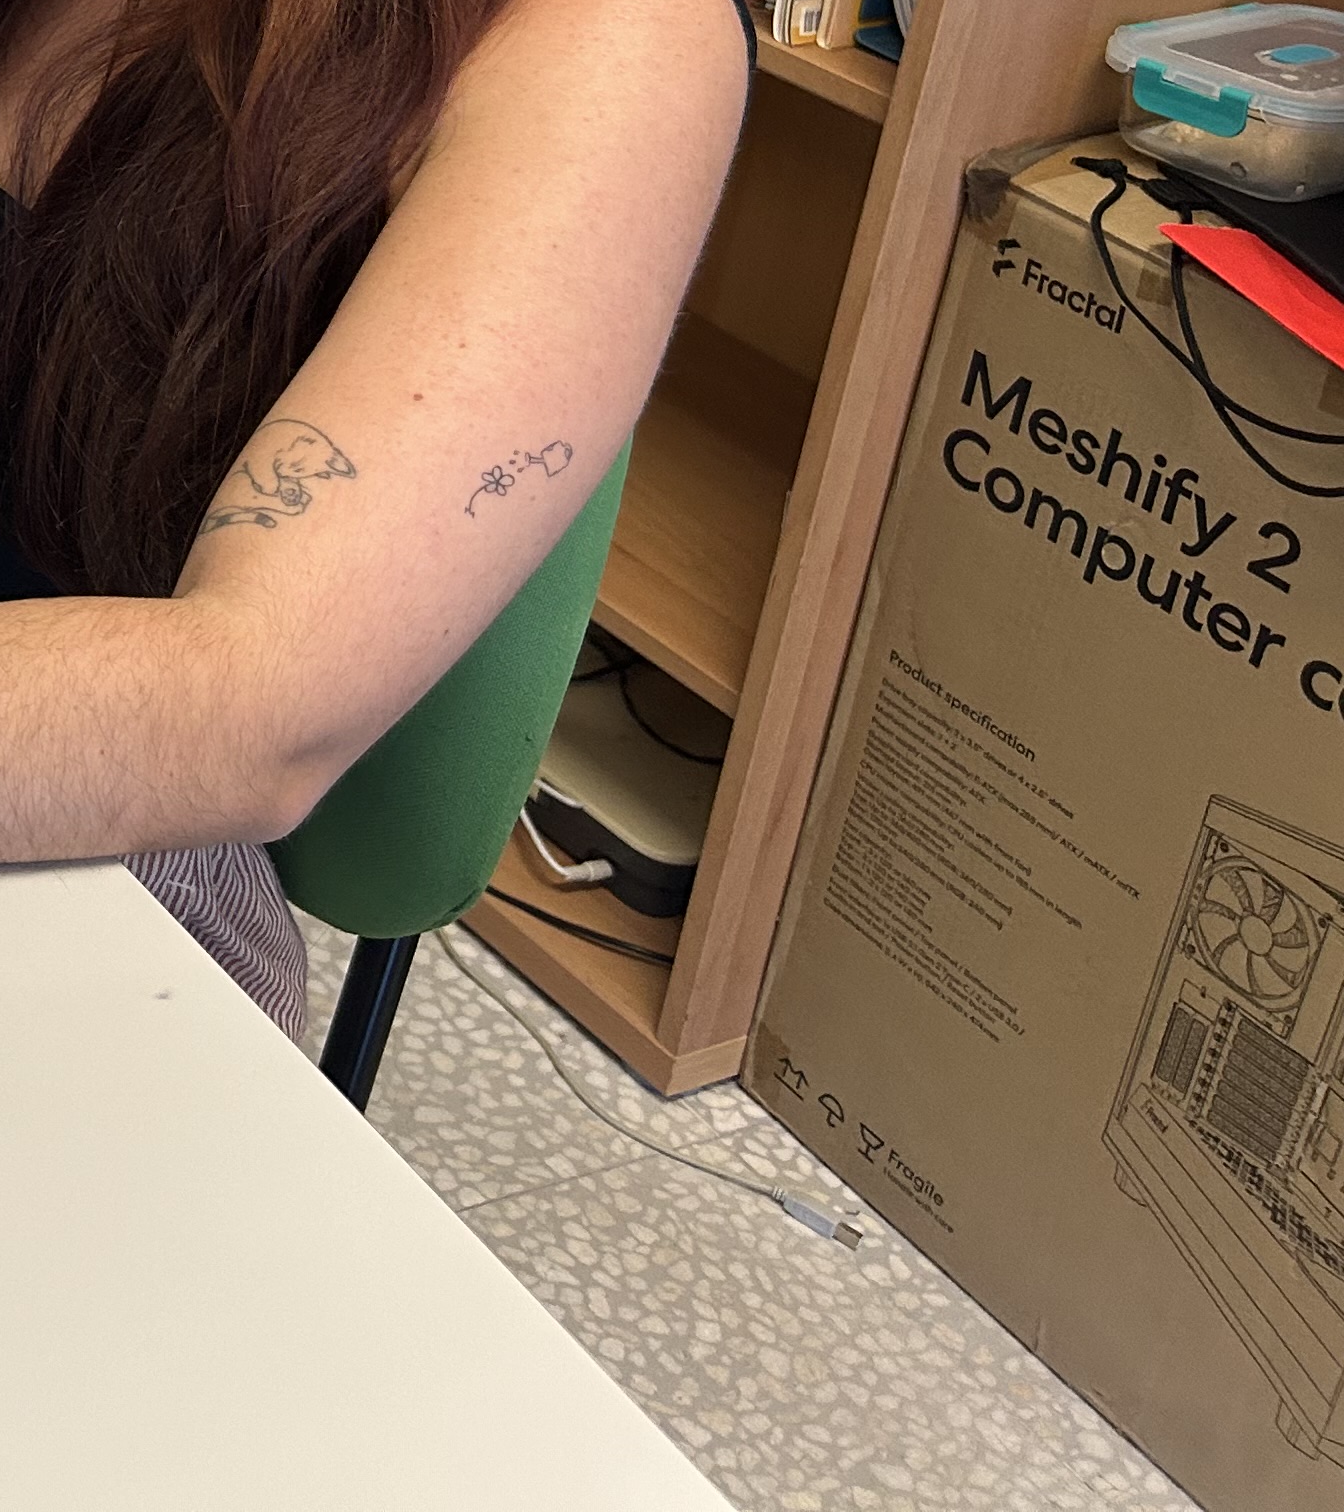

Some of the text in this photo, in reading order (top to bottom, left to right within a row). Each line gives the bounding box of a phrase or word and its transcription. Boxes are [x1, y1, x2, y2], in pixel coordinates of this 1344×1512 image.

[1019, 257, 1127, 335] Fractal
[959, 347, 1304, 595] Meshify 2
[942, 428, 1288, 672] Computer
[889, 648, 944, 697] Product
[943, 690, 1036, 763] specification
[887, 1149, 944, 1207] Fragile
